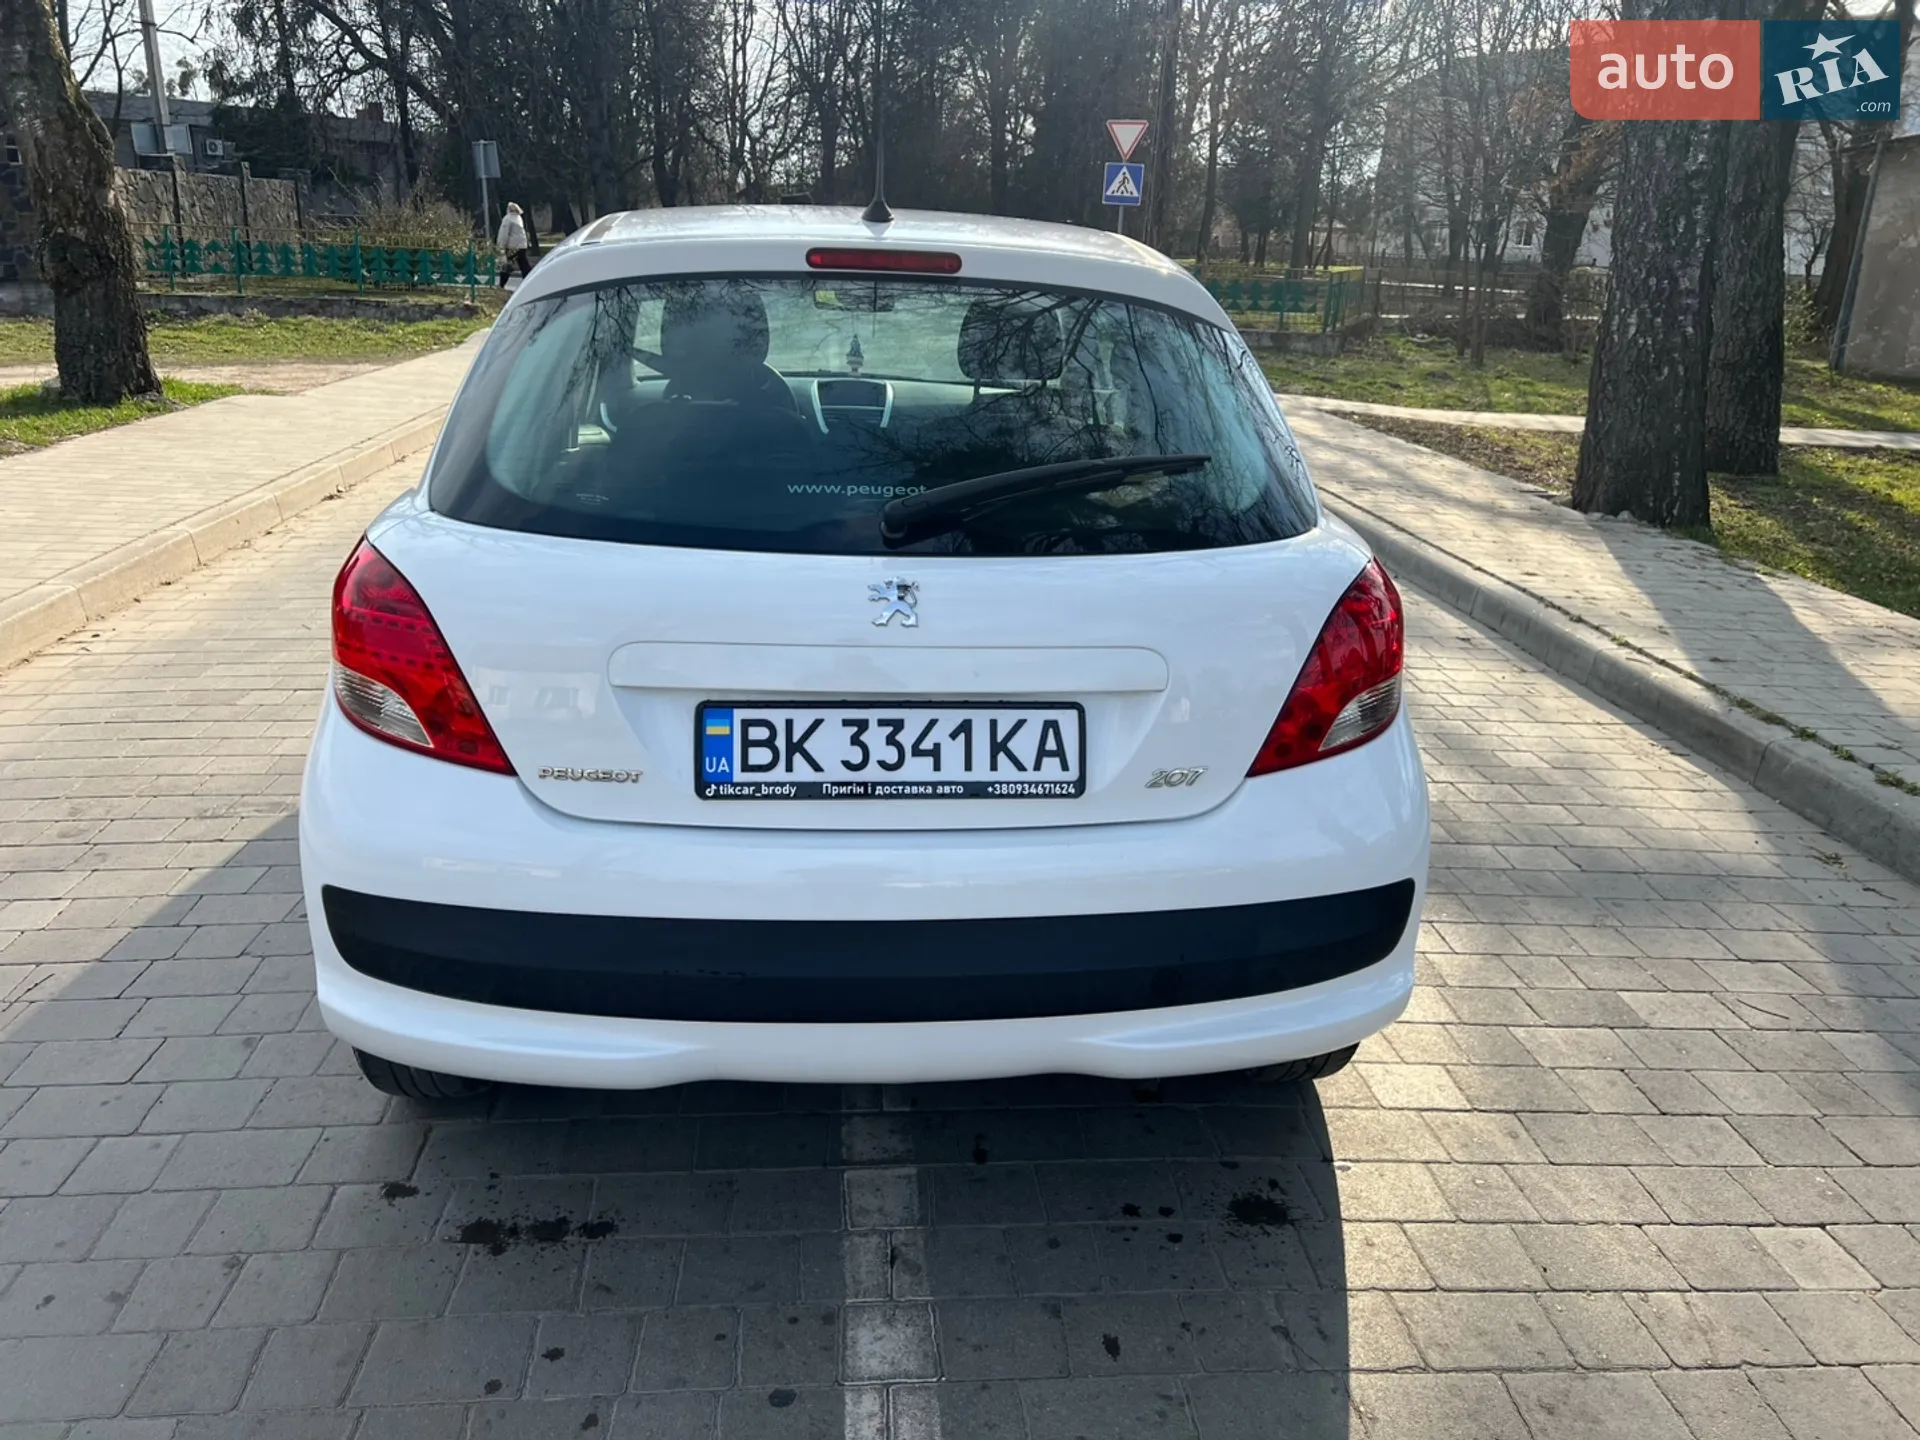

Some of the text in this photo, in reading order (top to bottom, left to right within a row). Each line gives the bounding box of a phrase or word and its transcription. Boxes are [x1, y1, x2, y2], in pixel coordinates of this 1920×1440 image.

[740, 718, 1071, 773] BK 3341 KA
[705, 758, 730, 773] UA
[539, 766, 643, 783] PEUGEOT
[1144, 766, 1208, 788] 207
[719, 784, 797, 797] tikcar_brody
[822, 783, 864, 796] Пригін
[875, 784, 933, 796] доставка
[936, 784, 964, 795] авто
[987, 784, 1076, 795] +380934671624
